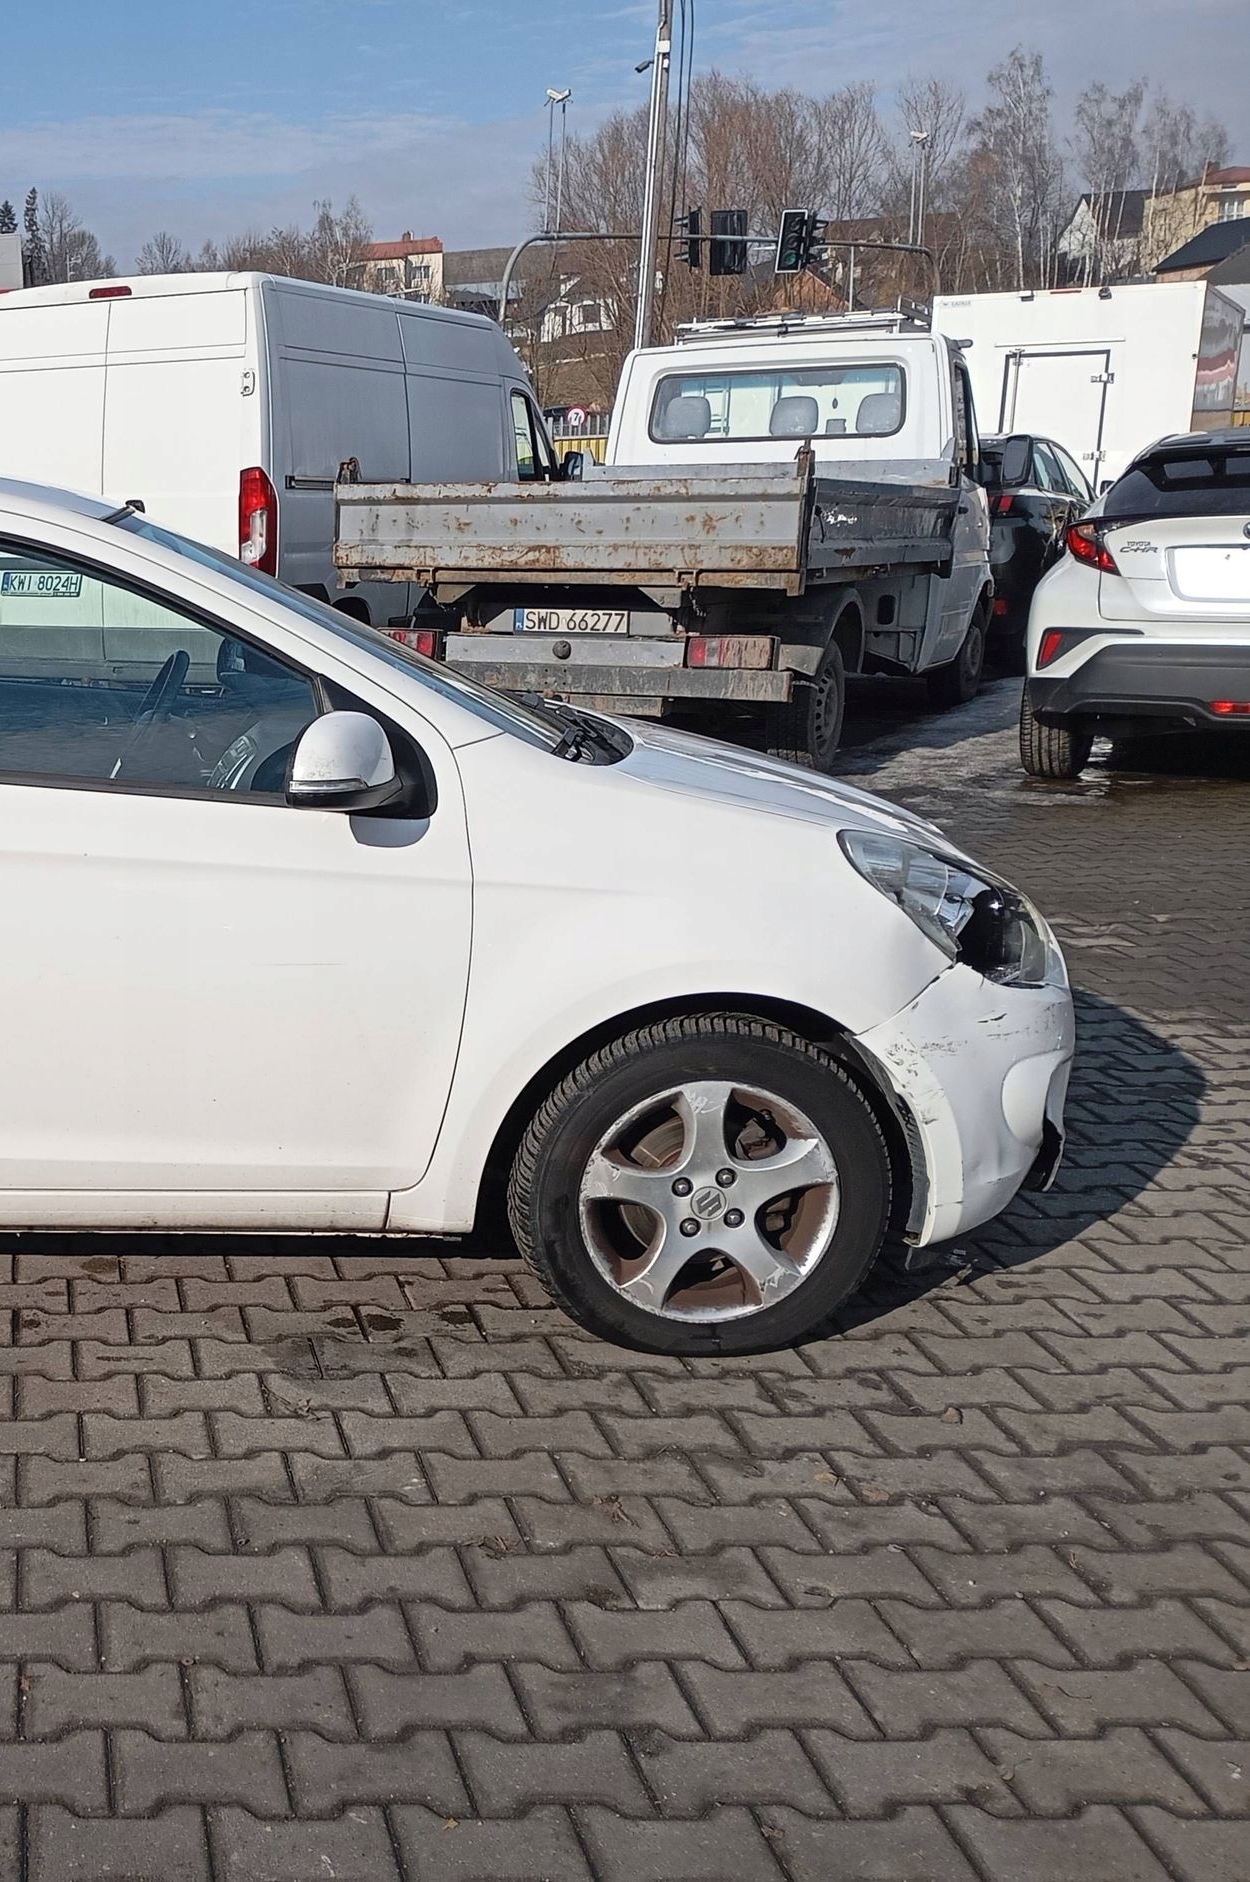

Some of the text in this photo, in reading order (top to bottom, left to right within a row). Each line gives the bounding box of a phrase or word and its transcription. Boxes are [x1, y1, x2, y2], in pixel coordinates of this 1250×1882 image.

[10, 575, 79, 592] KWI 8024H
[525, 611, 626, 632] SWD 66277
